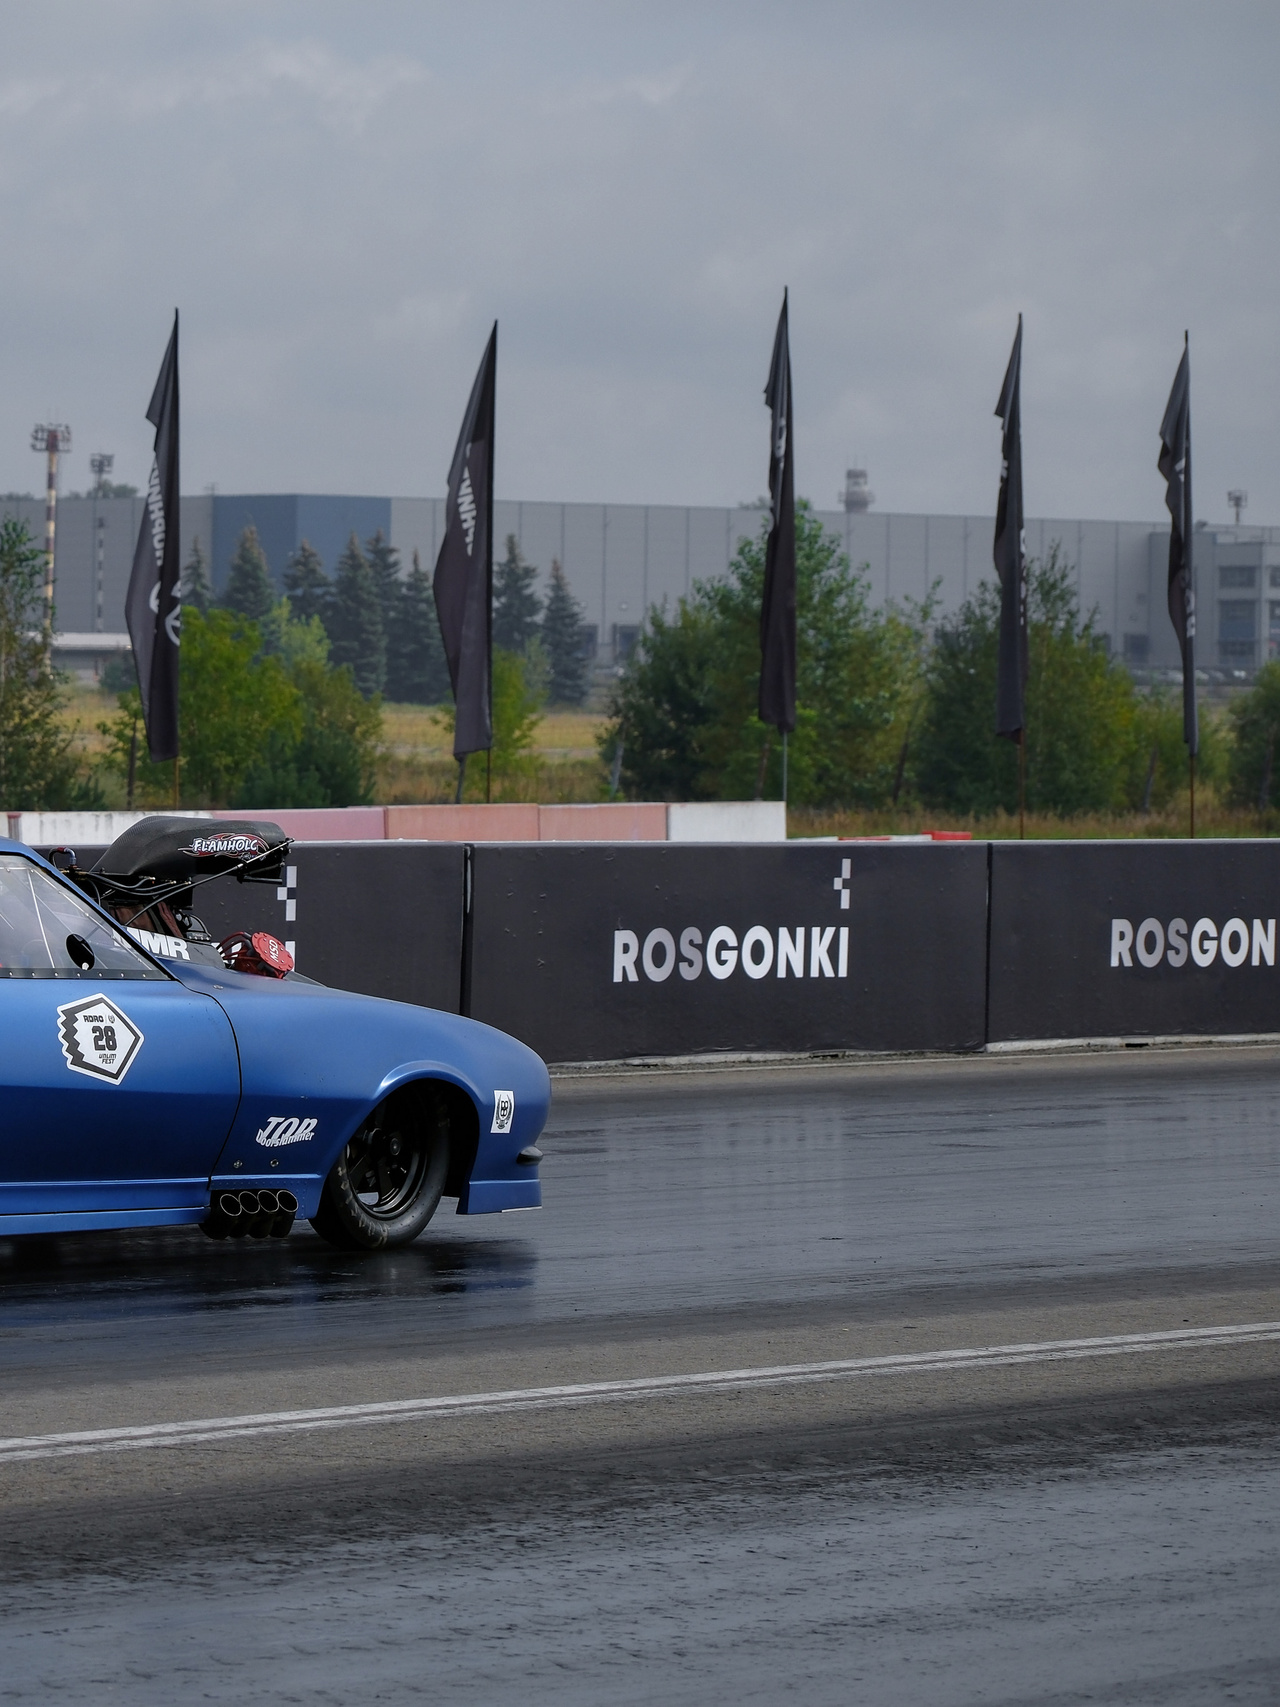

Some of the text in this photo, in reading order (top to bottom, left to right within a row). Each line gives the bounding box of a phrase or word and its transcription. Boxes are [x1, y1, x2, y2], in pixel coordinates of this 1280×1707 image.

[193, 838, 258, 852] FLAMHOLC
[269, 939, 279, 963] MSD
[613, 925, 849, 982] ROSGONKI
[1110, 917, 1276, 968] ROSGON
[91, 1026, 117, 1051] 28
[255, 1128, 315, 1147] Doorslammer
[263, 1116, 318, 1139] TOP
